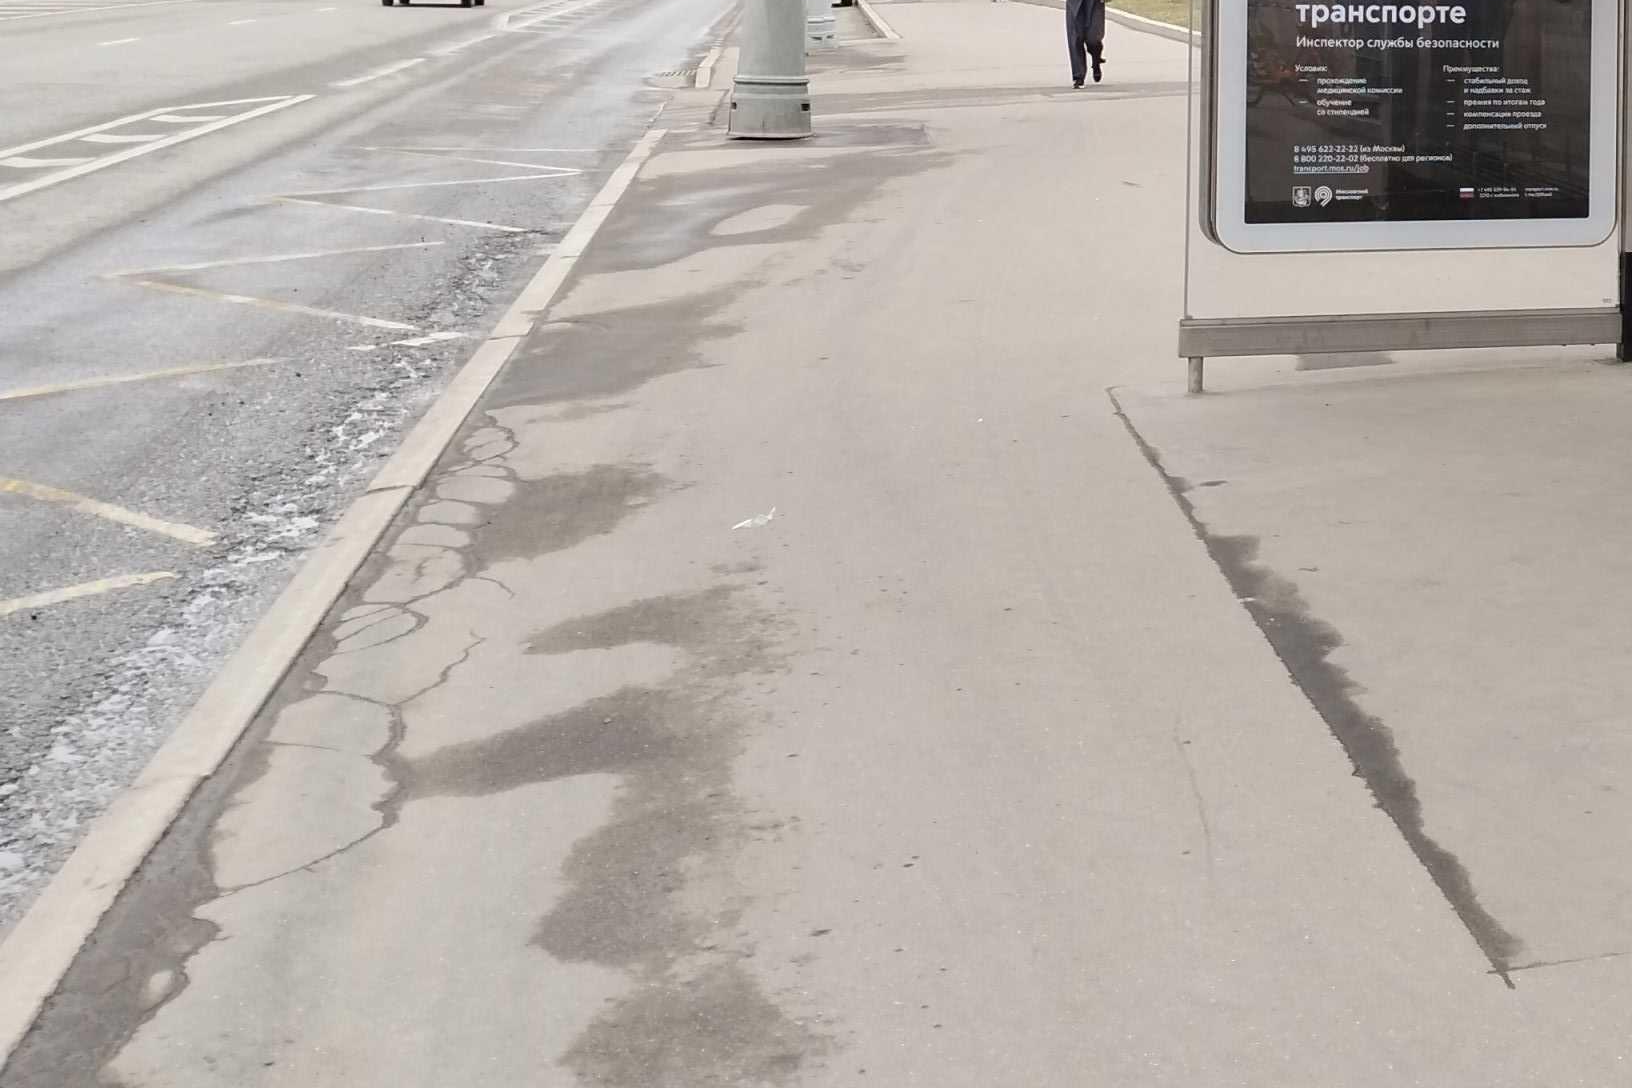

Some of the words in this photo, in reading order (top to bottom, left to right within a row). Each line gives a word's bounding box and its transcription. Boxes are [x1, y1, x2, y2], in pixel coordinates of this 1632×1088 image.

[1296, 3, 1467, 29] транспорте
[1296, 36, 1364, 49] Инспектор
[1367, 37, 1414, 50] службы
[1416, 37, 1500, 49] безопасности
[1294, 145, 1300, 153] 8
[1318, 145, 1359, 153] 622-22-22
